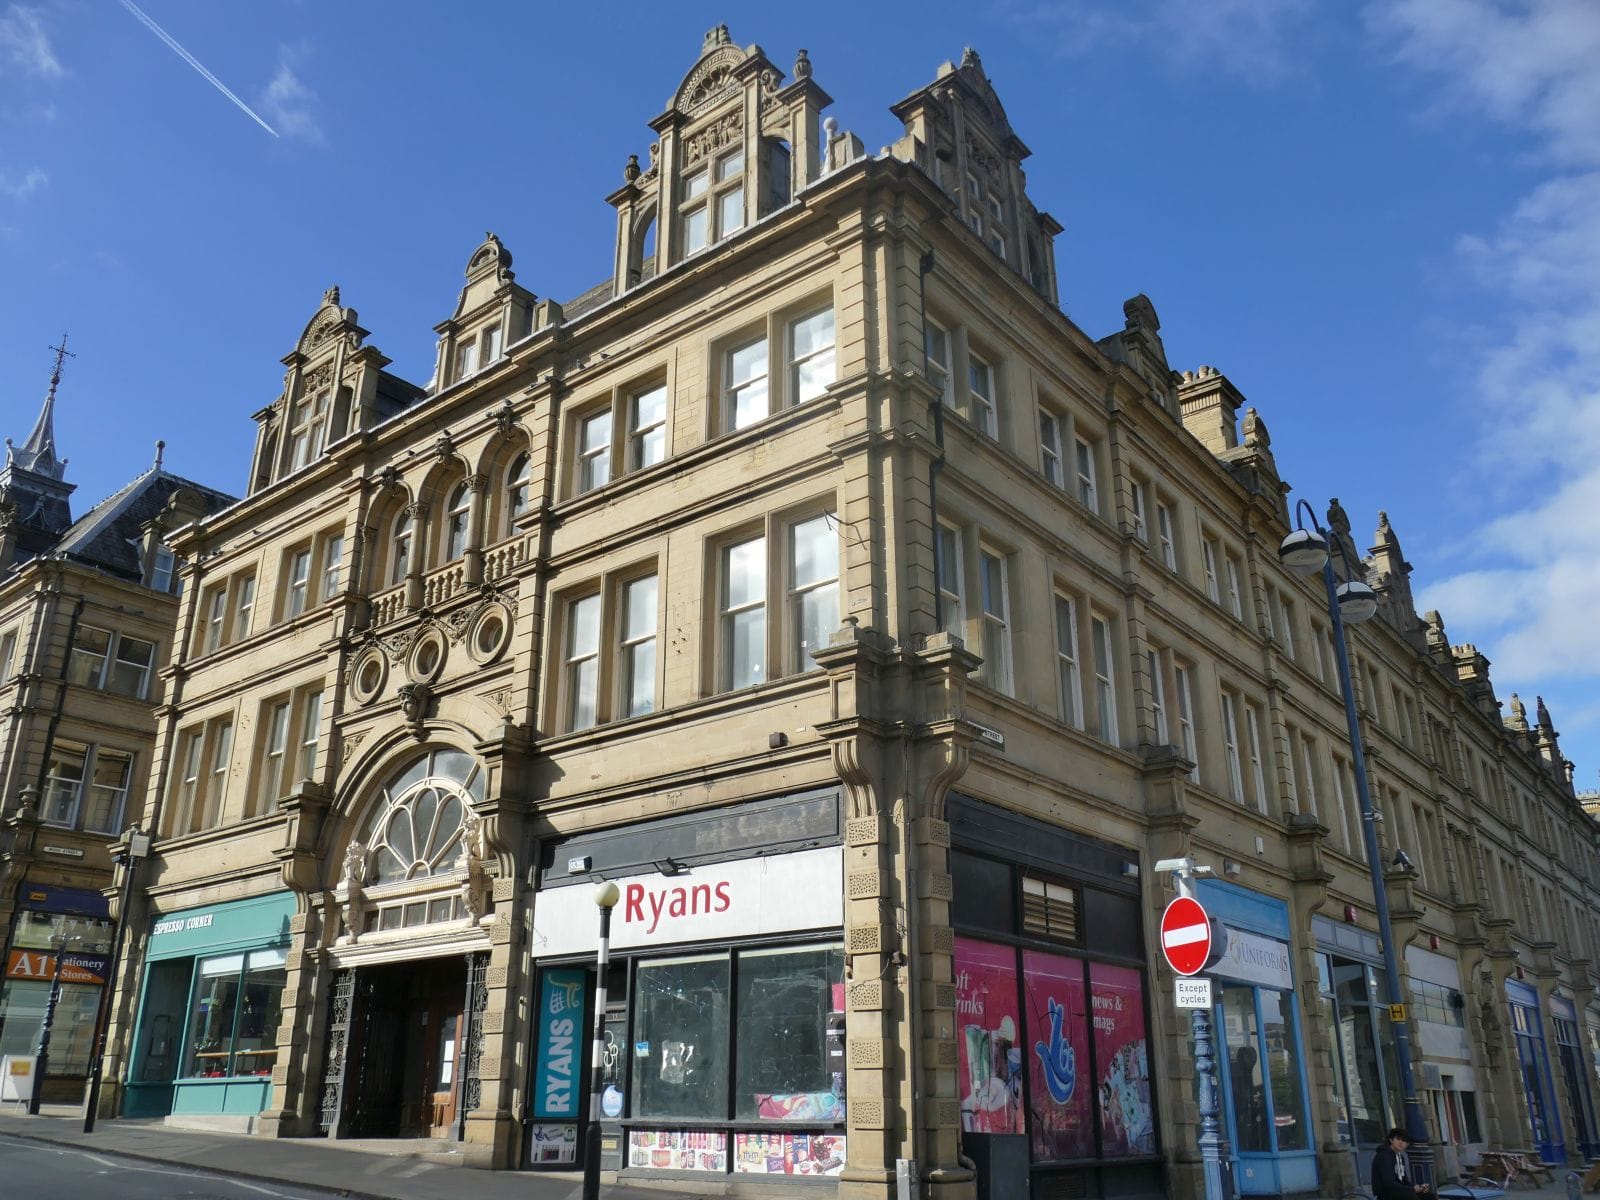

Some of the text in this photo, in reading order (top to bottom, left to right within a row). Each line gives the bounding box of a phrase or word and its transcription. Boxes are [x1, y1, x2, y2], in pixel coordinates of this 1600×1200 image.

[625, 881, 731, 934] Ryans
[153, 914, 214, 935] ESPRESSO CORNER
[10, 952, 51, 977] A1
[53, 956, 105, 971] ationery
[61, 968, 92, 981] Stores
[1179, 983, 1208, 993] Except
[955, 993, 985, 1016] rinks
[1092, 994, 1113, 1010] news
[1181, 995, 1206, 1004] cycles
[1390, 1005, 1404, 1019] H
[1093, 1015, 1115, 1035] mags
[546, 1018, 575, 1113] RYANS
